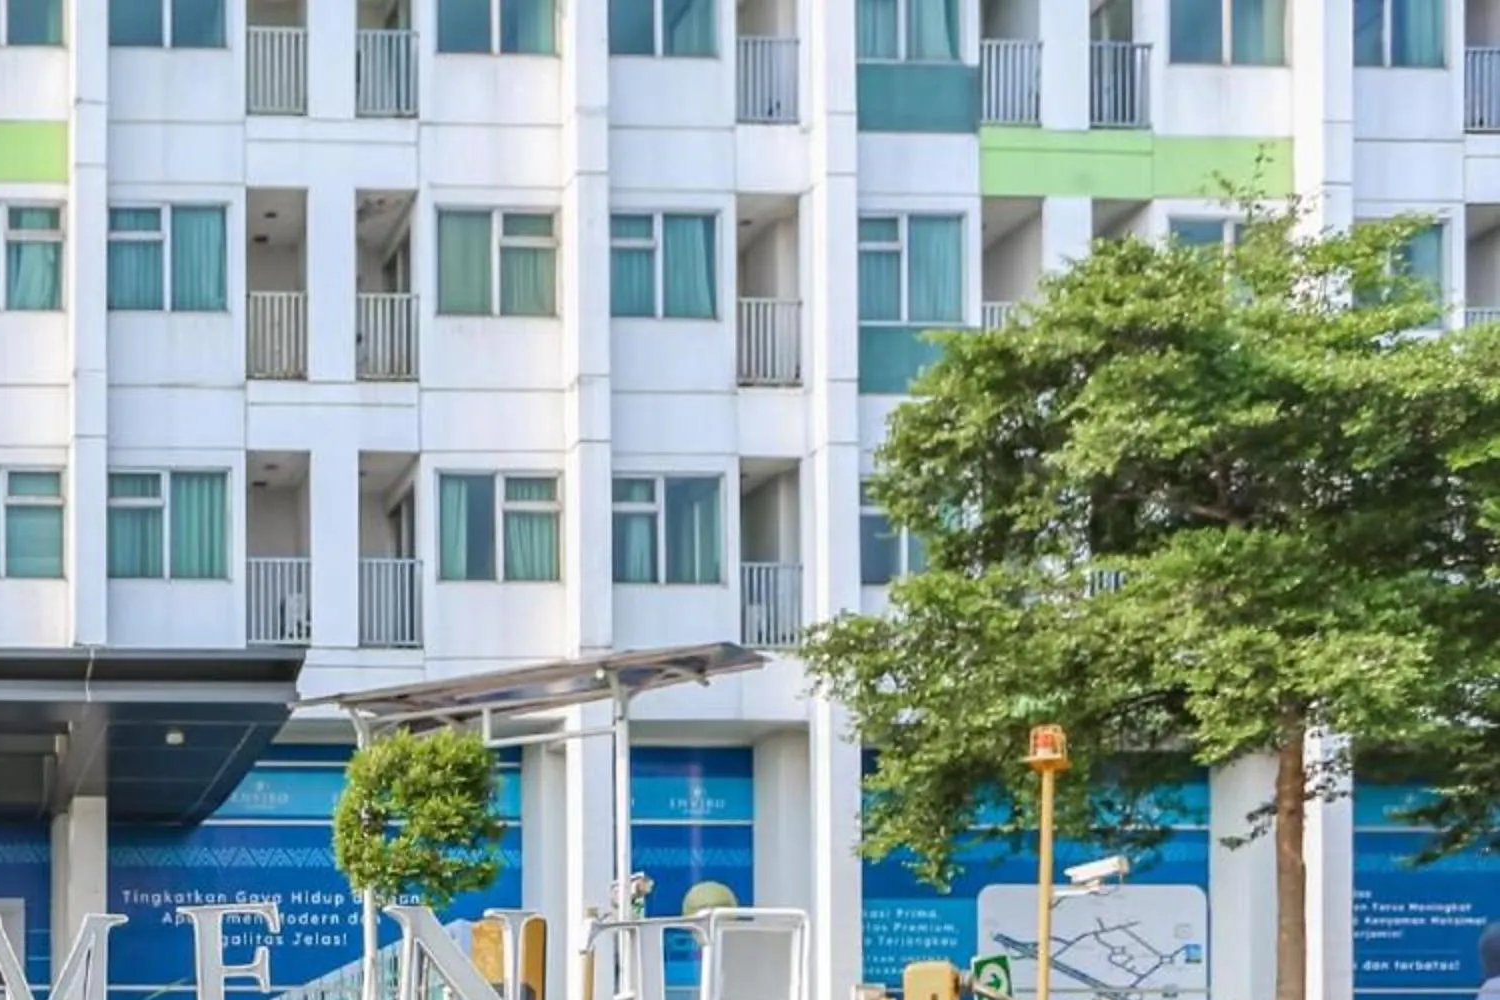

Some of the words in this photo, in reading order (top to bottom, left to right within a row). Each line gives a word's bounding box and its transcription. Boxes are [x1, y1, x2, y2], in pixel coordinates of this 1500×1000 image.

[121, 889, 227, 907] Tingkatkan
[235, 890, 282, 905] Gaya
[291, 889, 345, 907] Hidup
[223, 931, 284, 948] galitas
[292, 931, 348, 946] Jelas!
